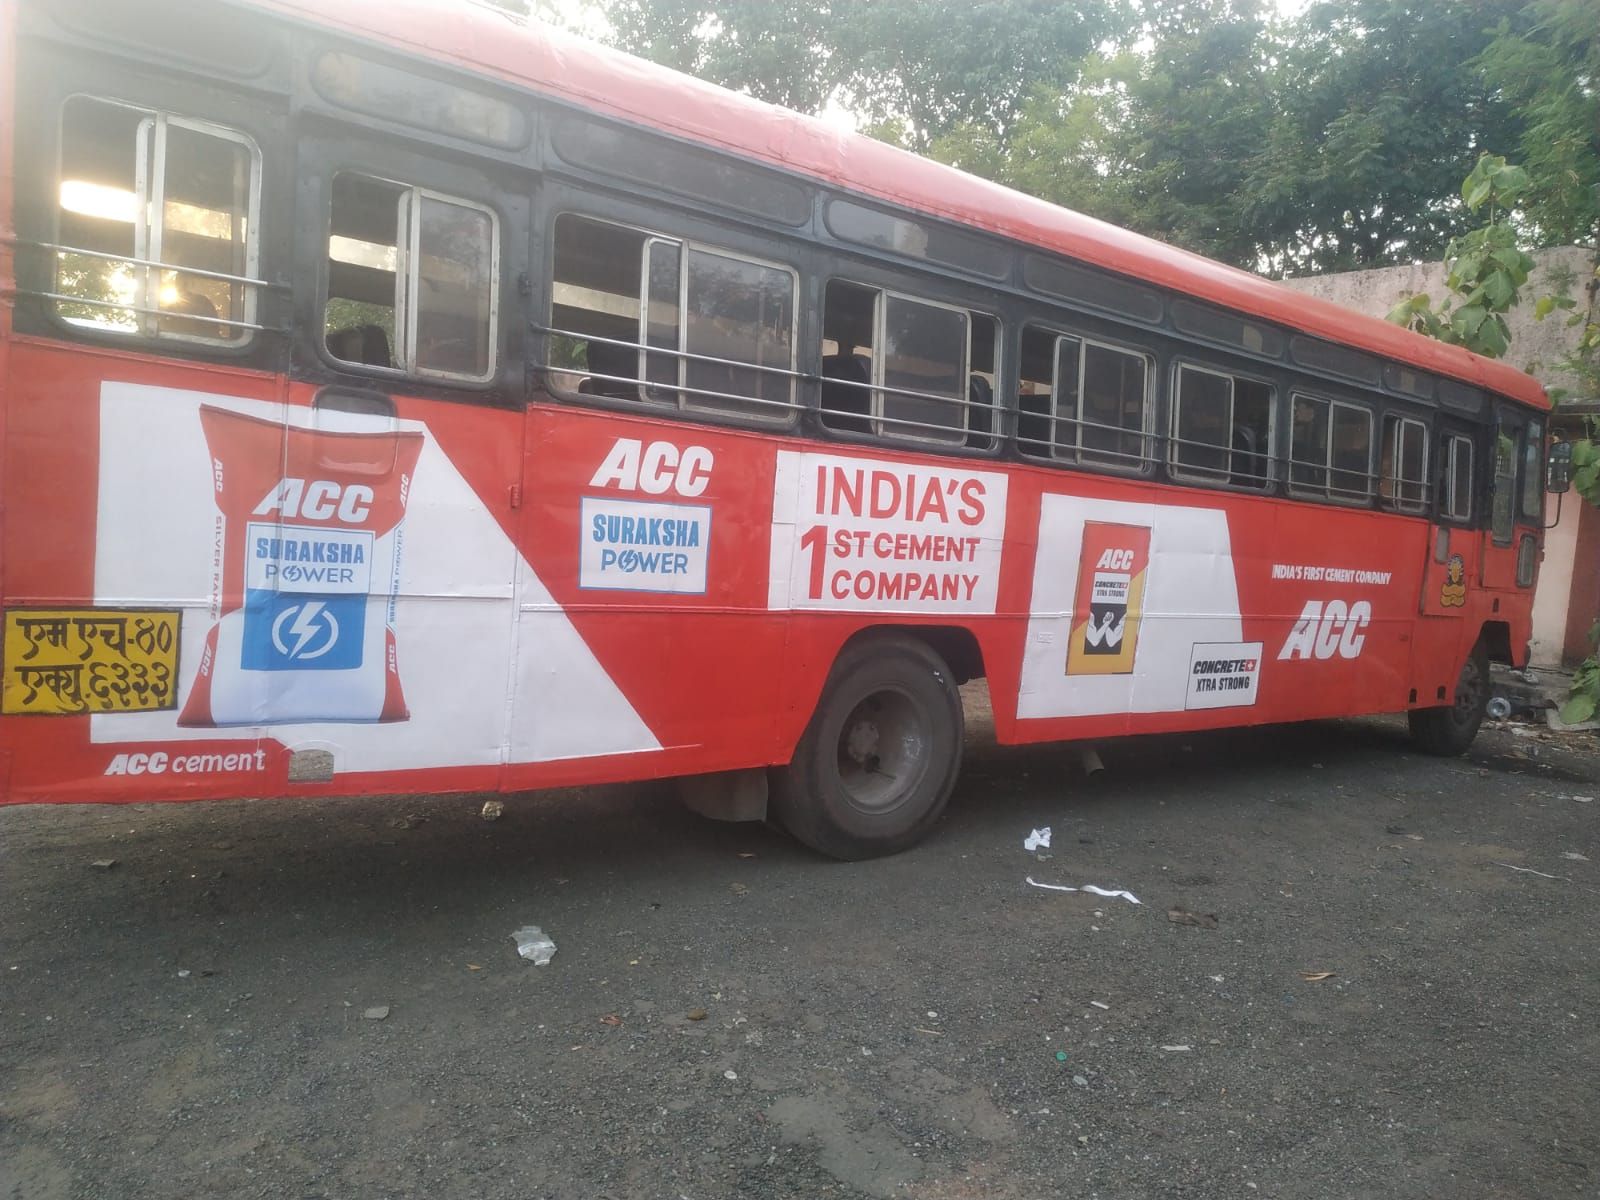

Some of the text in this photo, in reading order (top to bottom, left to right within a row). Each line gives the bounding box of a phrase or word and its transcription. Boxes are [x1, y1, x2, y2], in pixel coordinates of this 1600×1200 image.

[214, 457, 223, 492] ACC
[588, 437, 714, 497] ACC
[251, 477, 374, 523] ACC
[400, 473, 409, 507] ACC
[815, 465, 987, 526] INDIA'S
[592, 513, 699, 547] SURAKSHA
[256, 537, 364, 564] SURAKSHA
[601, 549, 689, 574] POWER
[873, 532, 981, 562] CEMENT
[1095, 548, 1134, 570] ACC
[210, 516, 222, 621] SILVER RANGE
[265, 563, 354, 583] POWER
[1271, 564, 1392, 585] INDIA'S FIRST CEMENT COMPANY
[830, 569, 980, 601] COMPANY
[1277, 600, 1372, 660] ACC
[200, 644, 212, 677] ACC
[388, 643, 397, 673] ACC
[1196, 676, 1250, 692] XTRA STRONG
[104, 750, 266, 775] ACC cement
